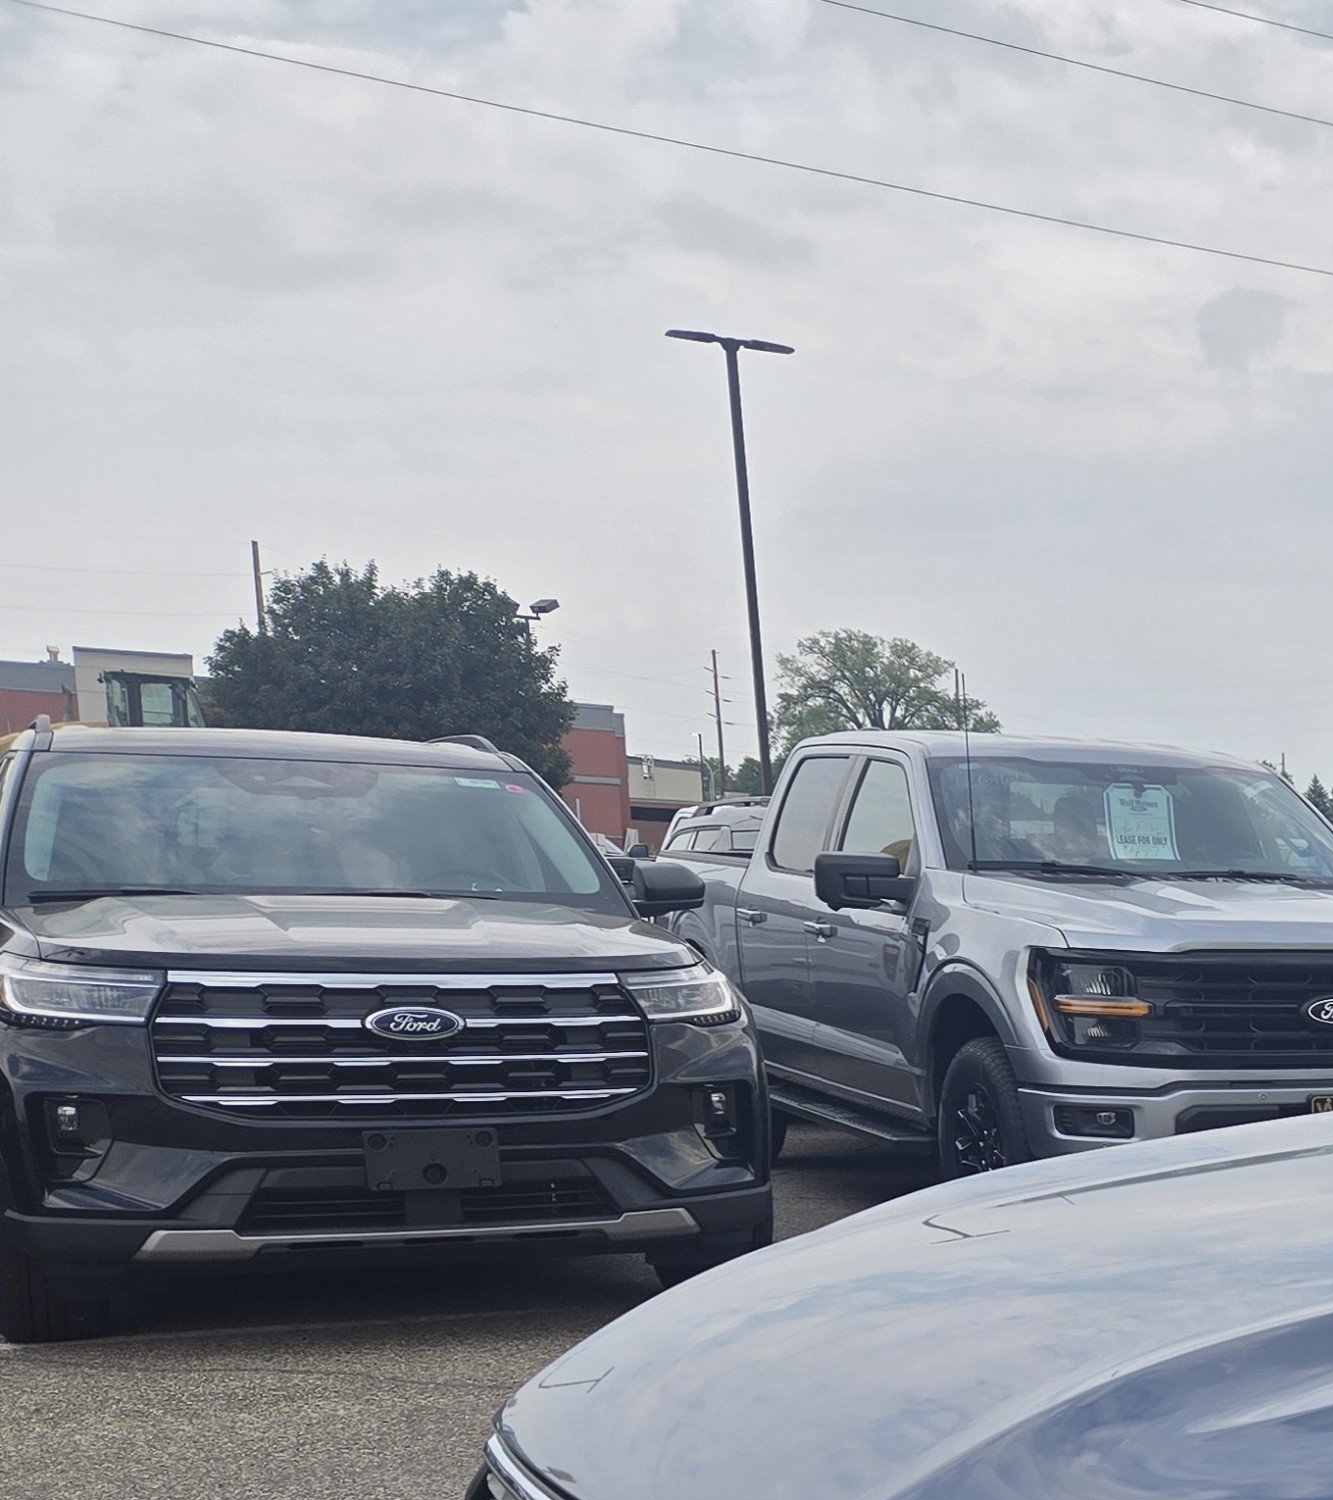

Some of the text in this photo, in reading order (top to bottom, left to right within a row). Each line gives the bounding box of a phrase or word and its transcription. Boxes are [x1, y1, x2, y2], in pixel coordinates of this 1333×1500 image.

[1116, 834, 1168, 846] LEASE FOR ONLY
[390, 1013, 441, 1032] Ford
